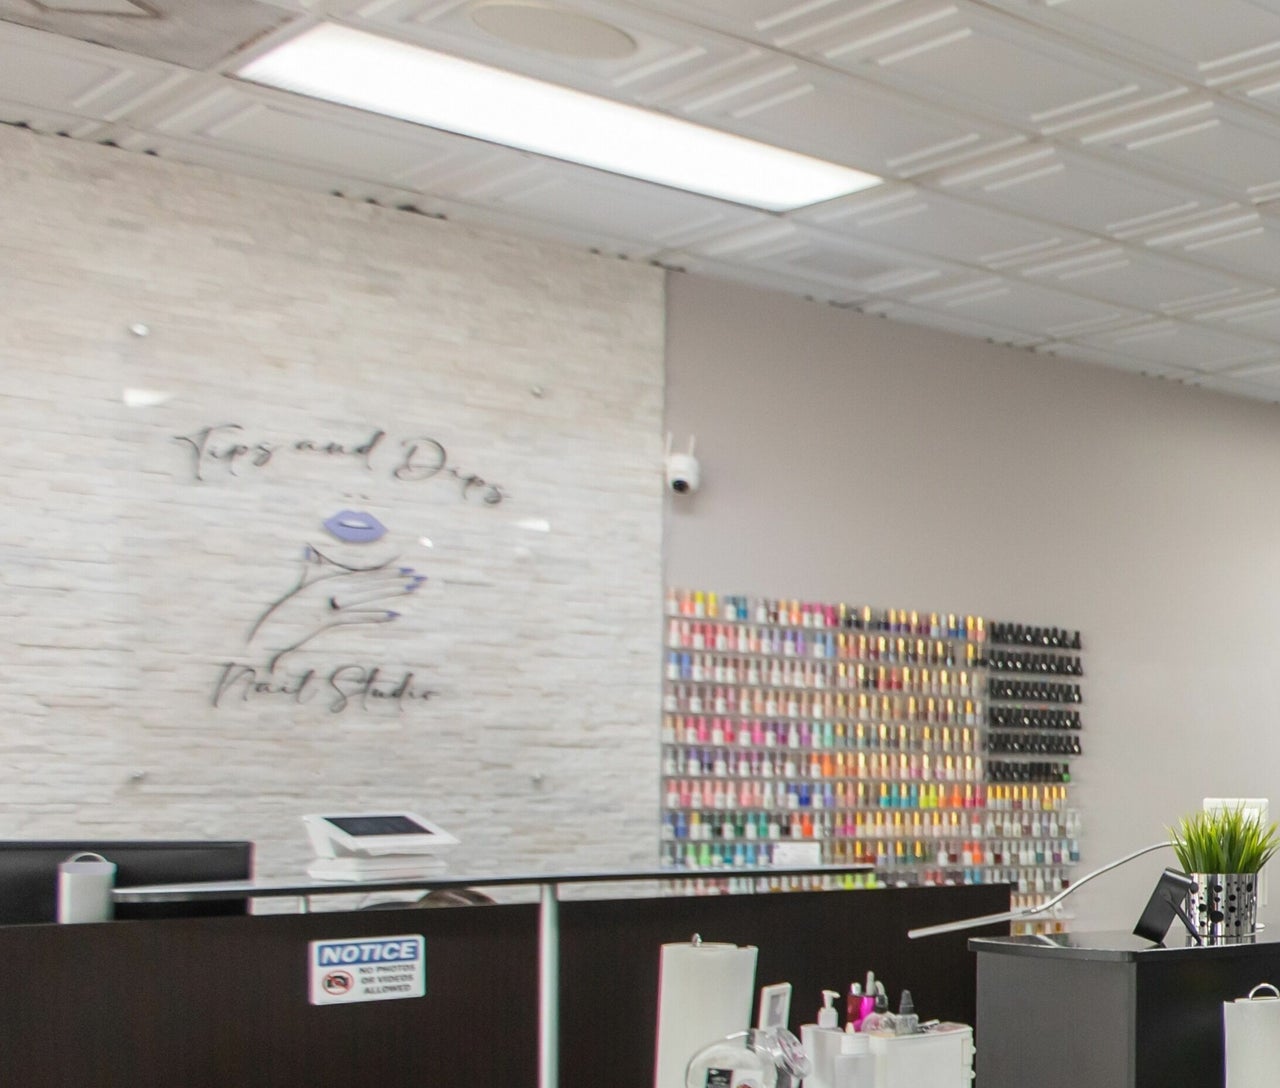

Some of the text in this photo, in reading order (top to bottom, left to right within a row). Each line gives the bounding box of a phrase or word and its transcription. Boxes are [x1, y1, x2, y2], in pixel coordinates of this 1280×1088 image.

[173, 424, 510, 505] Tips and Dips
[212, 662, 440, 714] Nail Studio
[321, 942, 416, 964] NOTICE
[359, 964, 416, 975] NO PHOTOS
[361, 974, 414, 985] OR VIDEOS
[364, 984, 412, 995] ALLOWED
